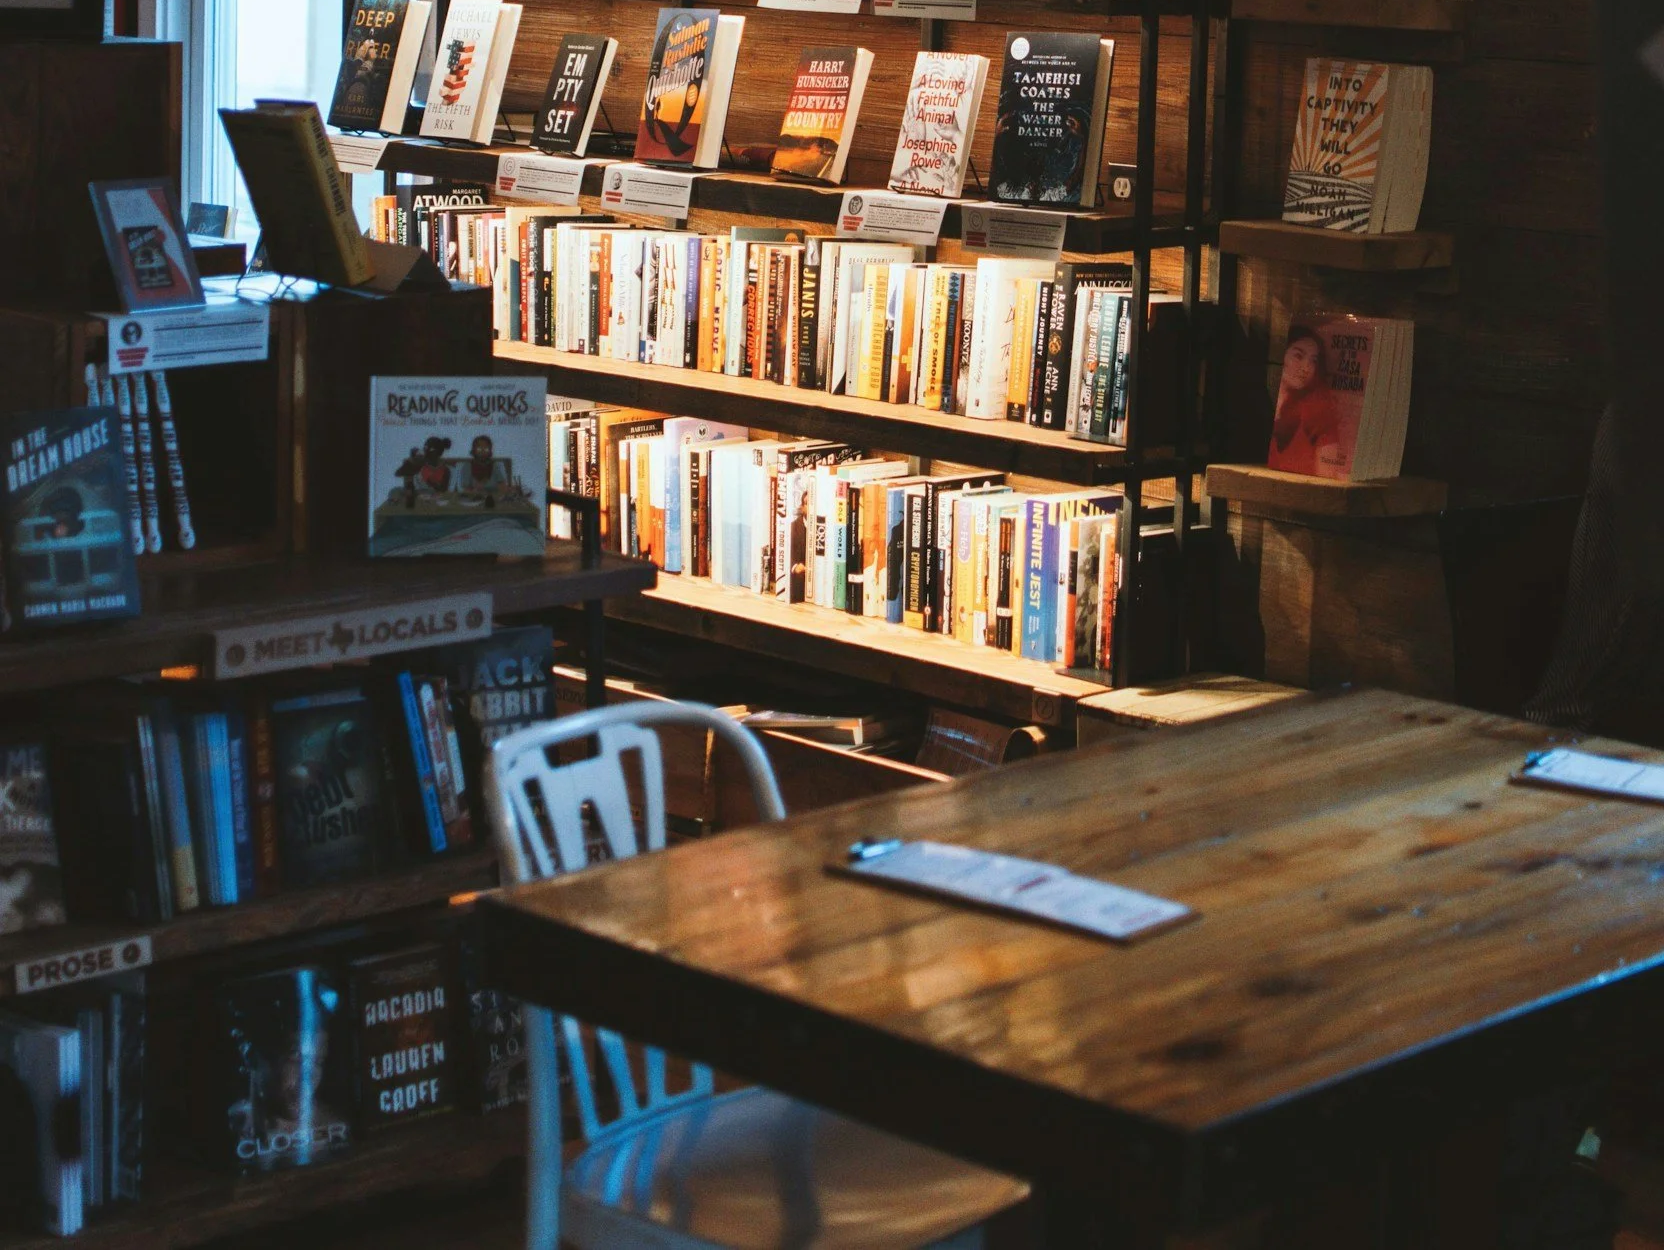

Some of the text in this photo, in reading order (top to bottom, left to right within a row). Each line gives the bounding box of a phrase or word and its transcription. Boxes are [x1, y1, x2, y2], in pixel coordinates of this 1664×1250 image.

[355, 9, 395, 28] DEEP
[449, 8, 493, 23] MICHAEL
[450, 27, 481, 40] LEWIS
[668, 17, 710, 47] Salman
[663, 34, 708, 69] Rushdie
[563, 53, 588, 76] EM
[809, 61, 844, 73] HARRY
[646, 56, 704, 111] Quichotte
[796, 76, 849, 89] HUNSICKER
[920, 74, 967, 94] A Loving,
[1014, 71, 1081, 85] TA-NEHISI
[1329, 77, 1362, 92] INTO
[553, 78, 583, 102] PTY
[917, 91, 960, 108] Faithful
[1020, 86, 1070, 99] COATES
[427, 102, 471, 115] THE FIFTH
[796, 95, 847, 110] DEVIL'S
[1033, 102, 1054, 113] THE
[1307, 96, 1378, 116] CAPTIVITY
[434, 118, 454, 130] RISK
[544, 109, 574, 134] SET
[786, 111, 843, 129] COUNTRY
[916, 108, 955, 124] Animal
[1022, 114, 1061, 125] WATER
[1321, 117, 1359, 134] THEY
[1018, 126, 1063, 138] DANCER
[902, 135, 957, 155] Josephine
[1320, 138, 1350, 155] WILL
[911, 153, 941, 169] Rowe
[1323, 161, 1342, 175] GO
[413, 195, 484, 211] ATWOOD
[1309, 185, 1346, 200] NOAM
[1296, 203, 1356, 220] MILLIGAN
[712, 248, 723, 354] OPTIC NERVE
[801, 268, 817, 318] JANIS
[1037, 287, 1048, 356] NIGHT JOURNEY
[1049, 292, 1059, 330] TOWER
[1055, 293, 1066, 331] RAVEN
[1101, 301, 1115, 332] DENNIS
[746, 285, 756, 363] CORRECTIONS
[871, 322, 884, 362] RICHARD
[930, 301, 942, 392] TREE OF SMOKE
[961, 320, 972, 363] KOONTZ
[1099, 335, 1112, 367] LEHANE
[870, 366, 880, 389] FORD
[1043, 361, 1052, 394] LECKIE
[1051, 367, 1059, 391] ANN
[388, 390, 529, 418] READING QUIRKS
[546, 401, 572, 412] DAVID
[11, 426, 48, 459] IN THE
[7, 418, 110, 493] DREAM HOUSE
[778, 530, 786, 547] TODD
[836, 526, 844, 558] WORLD
[909, 496, 922, 611] NEAL STEPHENSON CRYPTONOMICON
[1030, 502, 1044, 610] INFINITE JEST
[24, 602, 58, 618] CARMEN
[61, 599, 86, 613] MARIA
[253, 609, 458, 662] MEET LOCALS
[27, 950, 113, 987] PROSE
[365, 986, 446, 1027] ARCADIA
[370, 1041, 446, 1080] LAUREN
[379, 1077, 441, 1114] GROFF
